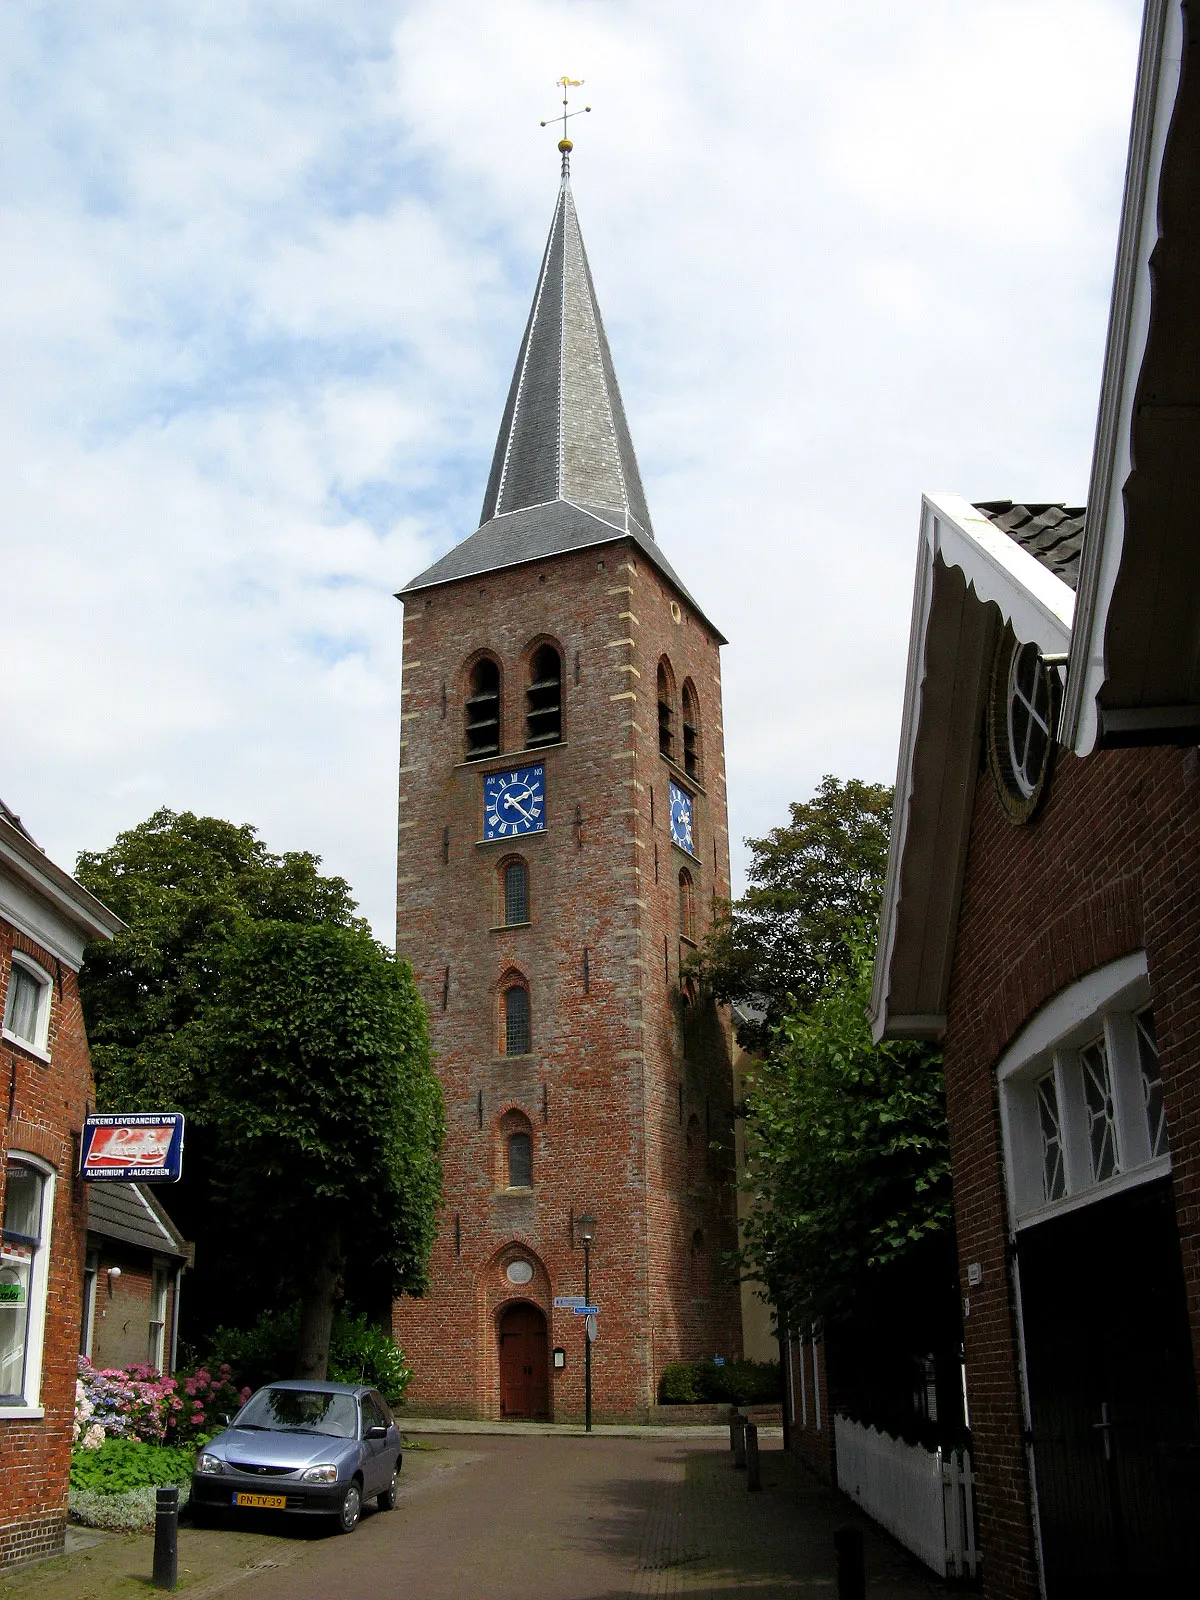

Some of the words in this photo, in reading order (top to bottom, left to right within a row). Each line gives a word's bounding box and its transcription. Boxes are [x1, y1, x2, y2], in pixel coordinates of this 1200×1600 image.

[534, 768, 543, 776] NO
[86, 1117, 114, 1125] ERKEND
[115, 1117, 161, 1125] LEVERANCIER
[161, 1116, 176, 1124] VAN
[86, 1168, 125, 1177] ALUMINIUM
[240, 1495, 282, 1507] PN-TV-39
